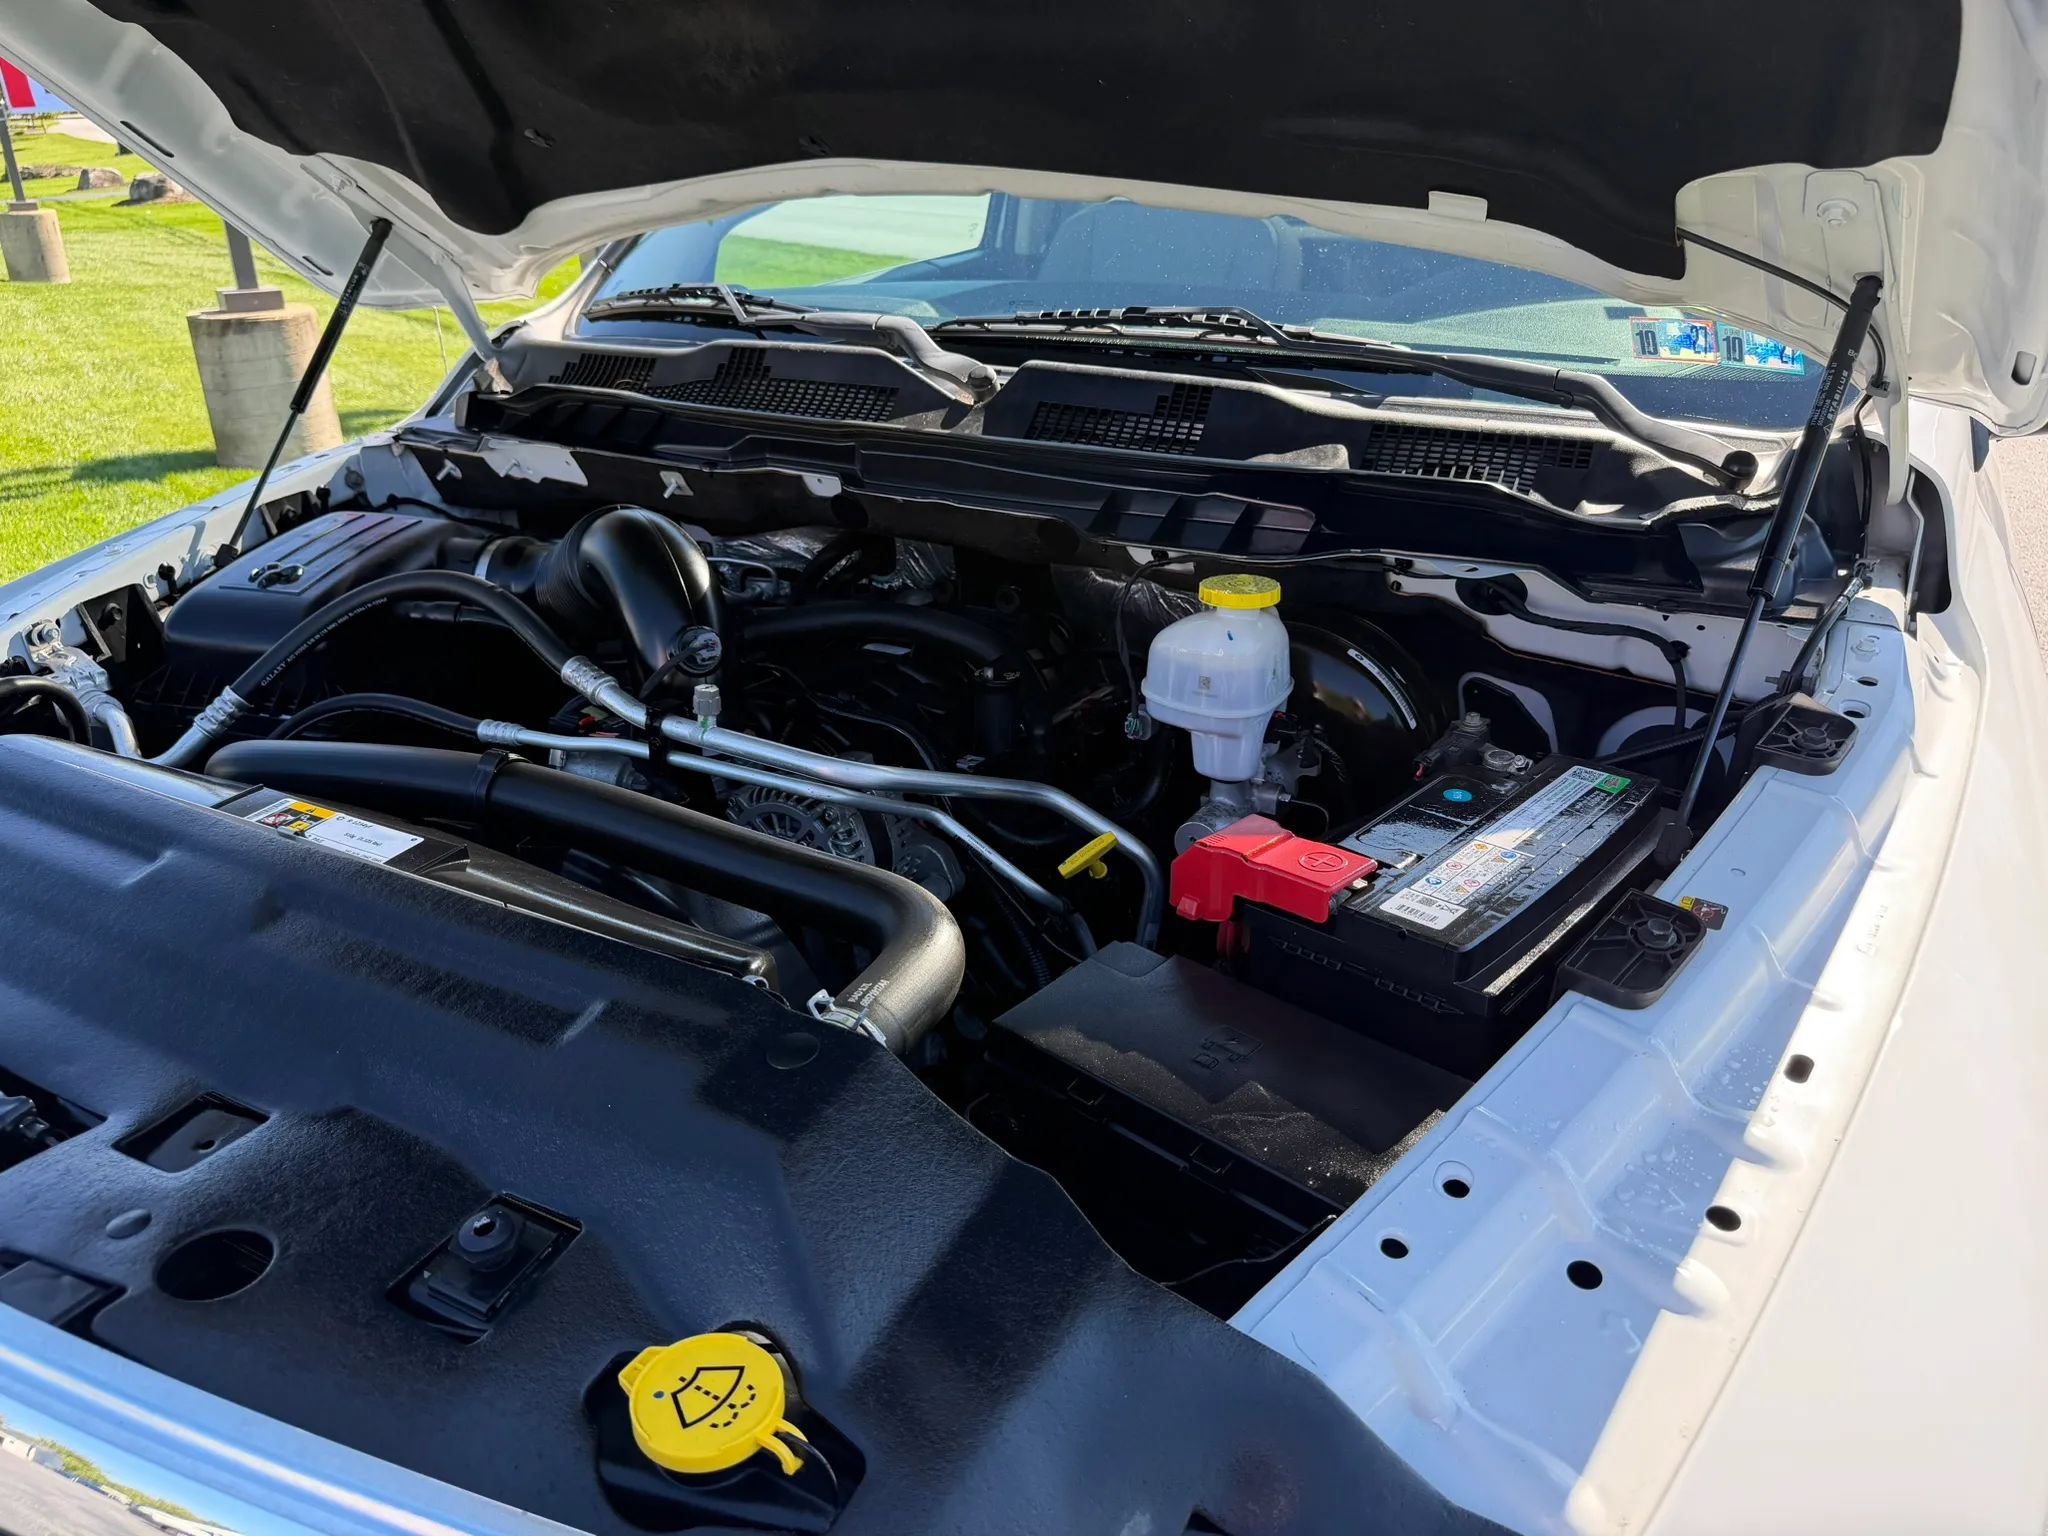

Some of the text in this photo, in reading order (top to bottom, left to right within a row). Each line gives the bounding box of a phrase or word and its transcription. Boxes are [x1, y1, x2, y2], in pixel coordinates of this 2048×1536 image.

[1636, 329, 1659, 356] 10
[1722, 335, 1744, 363] 10
[1827, 370, 1849, 421] STABILUS
[261, 660, 286, 687] GALAXY
